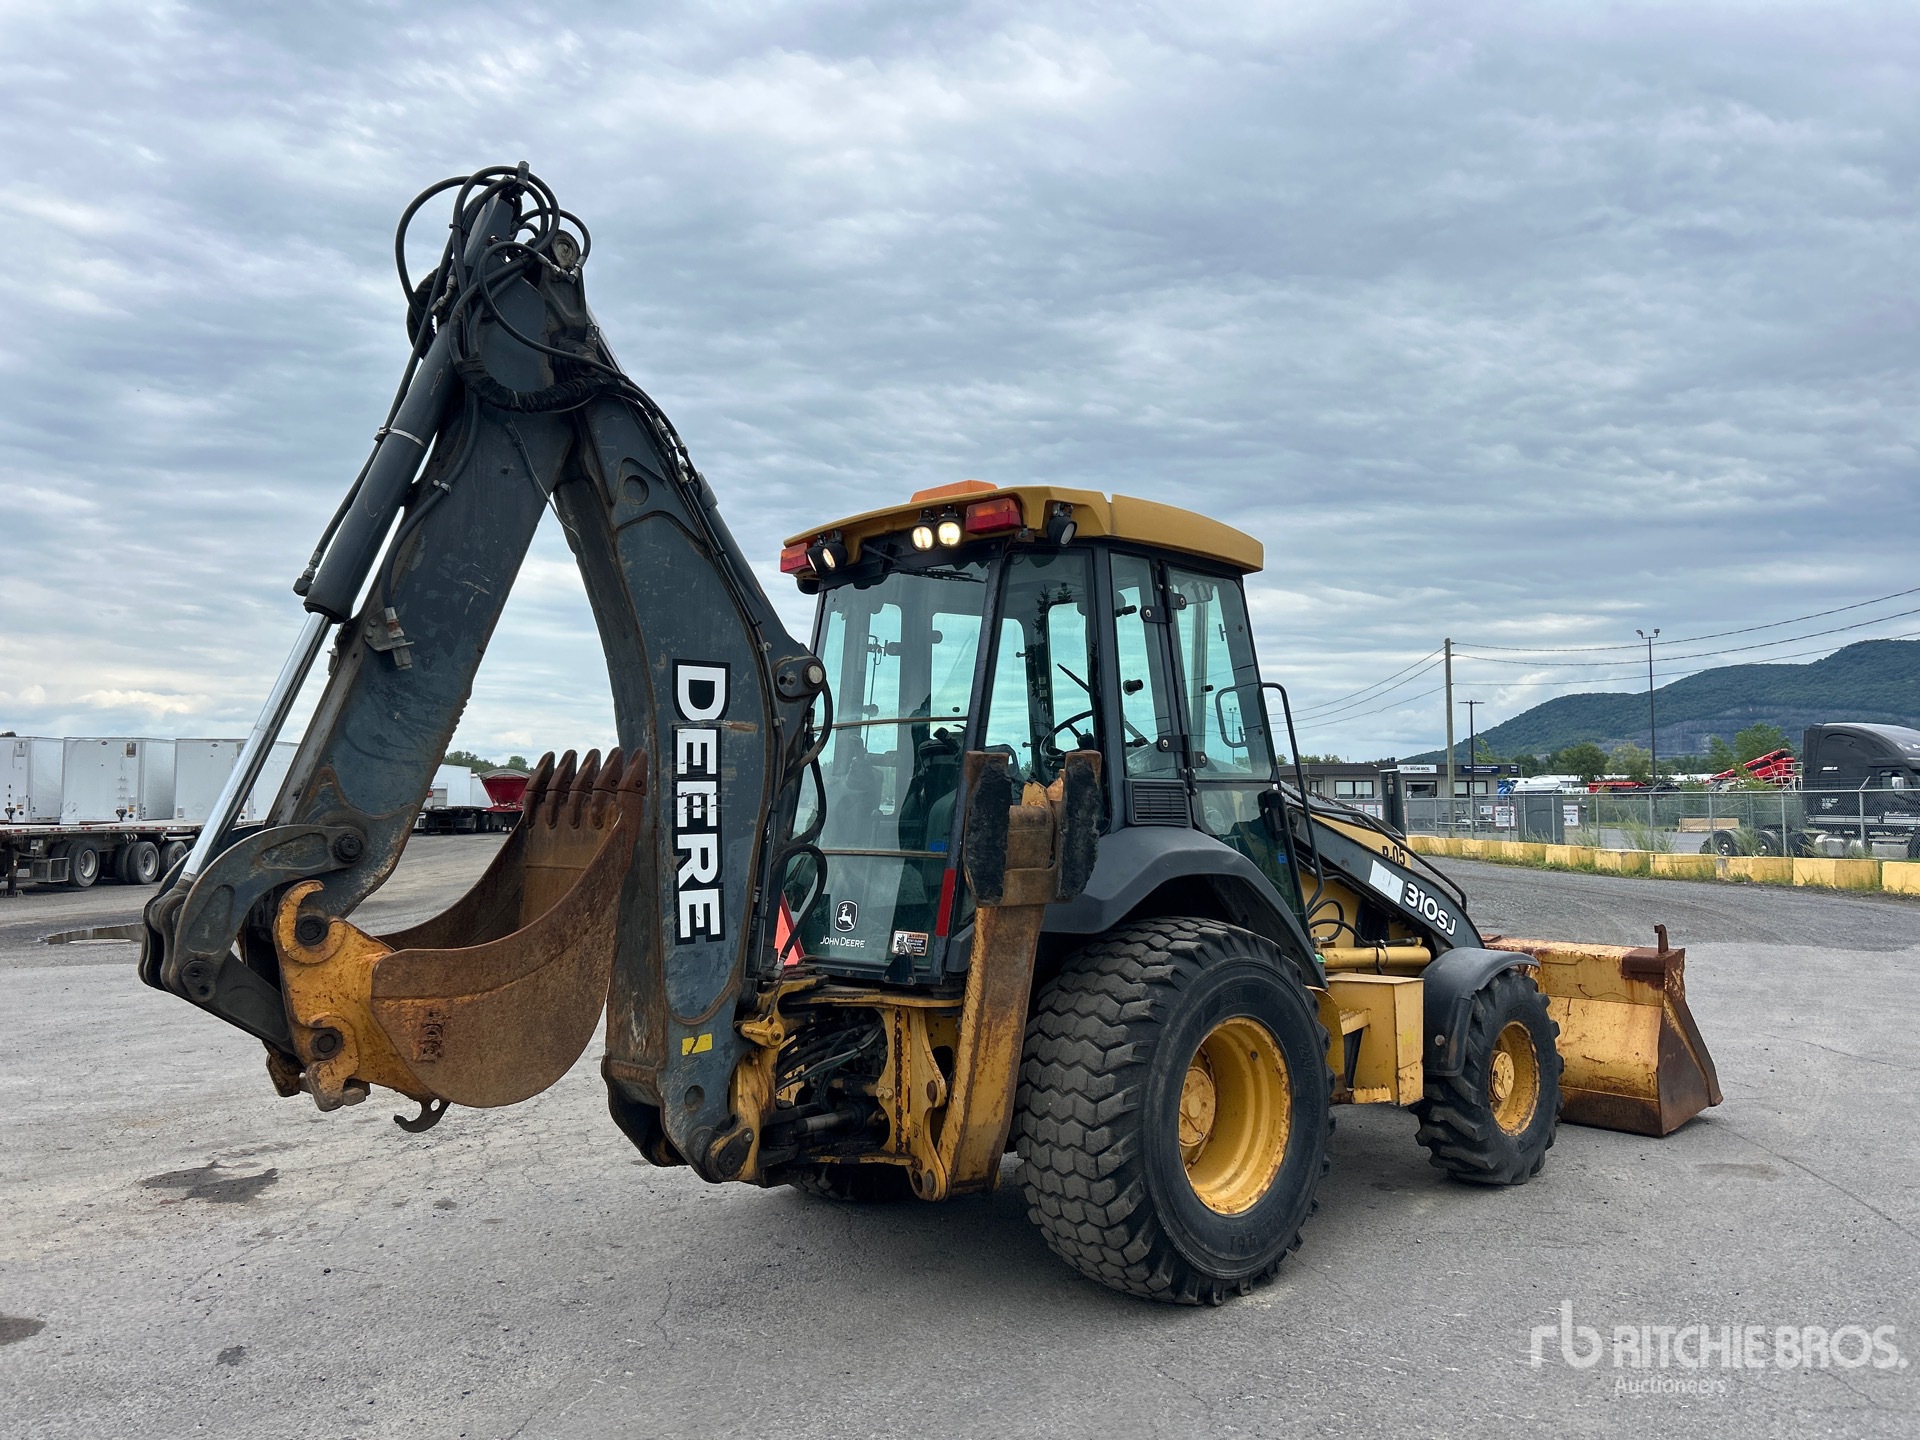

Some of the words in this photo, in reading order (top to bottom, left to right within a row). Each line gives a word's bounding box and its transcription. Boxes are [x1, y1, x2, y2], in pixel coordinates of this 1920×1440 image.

[675, 662, 728, 942] DEERE
[1404, 881, 1458, 937] 310SJ
[820, 935, 840, 946] JOHN
[840, 936, 866, 948] DEERE
